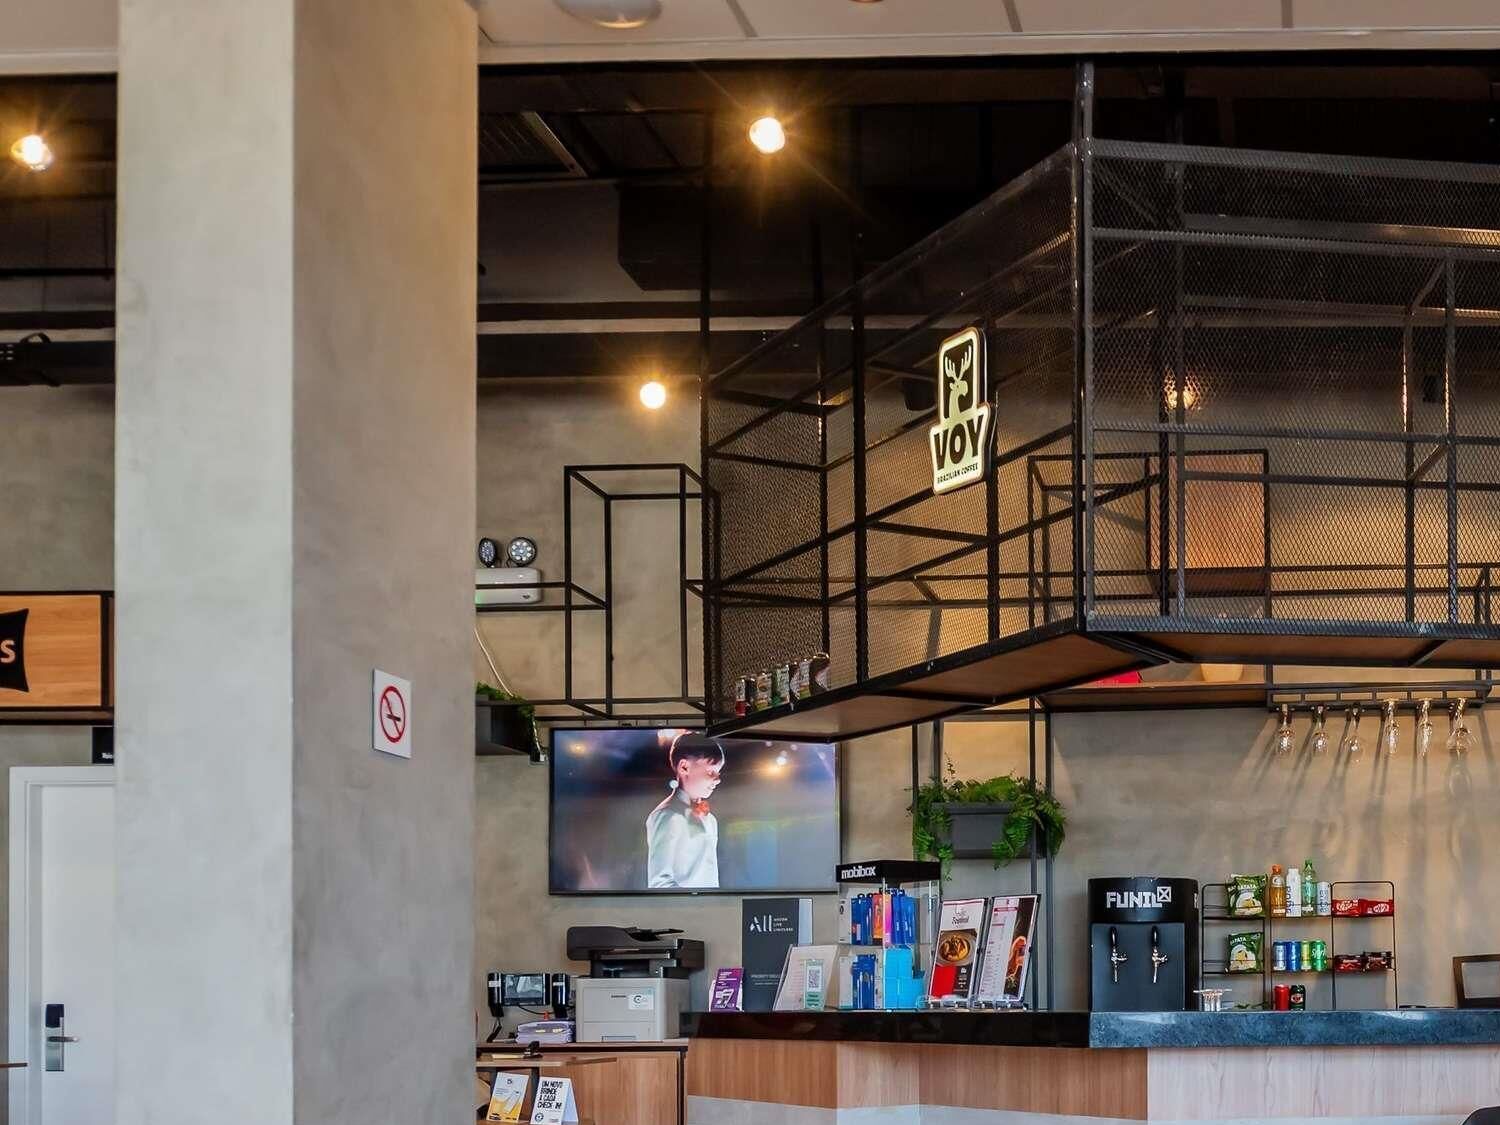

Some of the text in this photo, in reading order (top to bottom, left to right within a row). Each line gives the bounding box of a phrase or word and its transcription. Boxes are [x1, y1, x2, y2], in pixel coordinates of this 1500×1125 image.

[934, 414, 984, 471] VOY
[961, 462, 978, 475] COFFEE
[841, 865, 876, 879] mobibox
[1106, 891, 1163, 908] FUNIL
